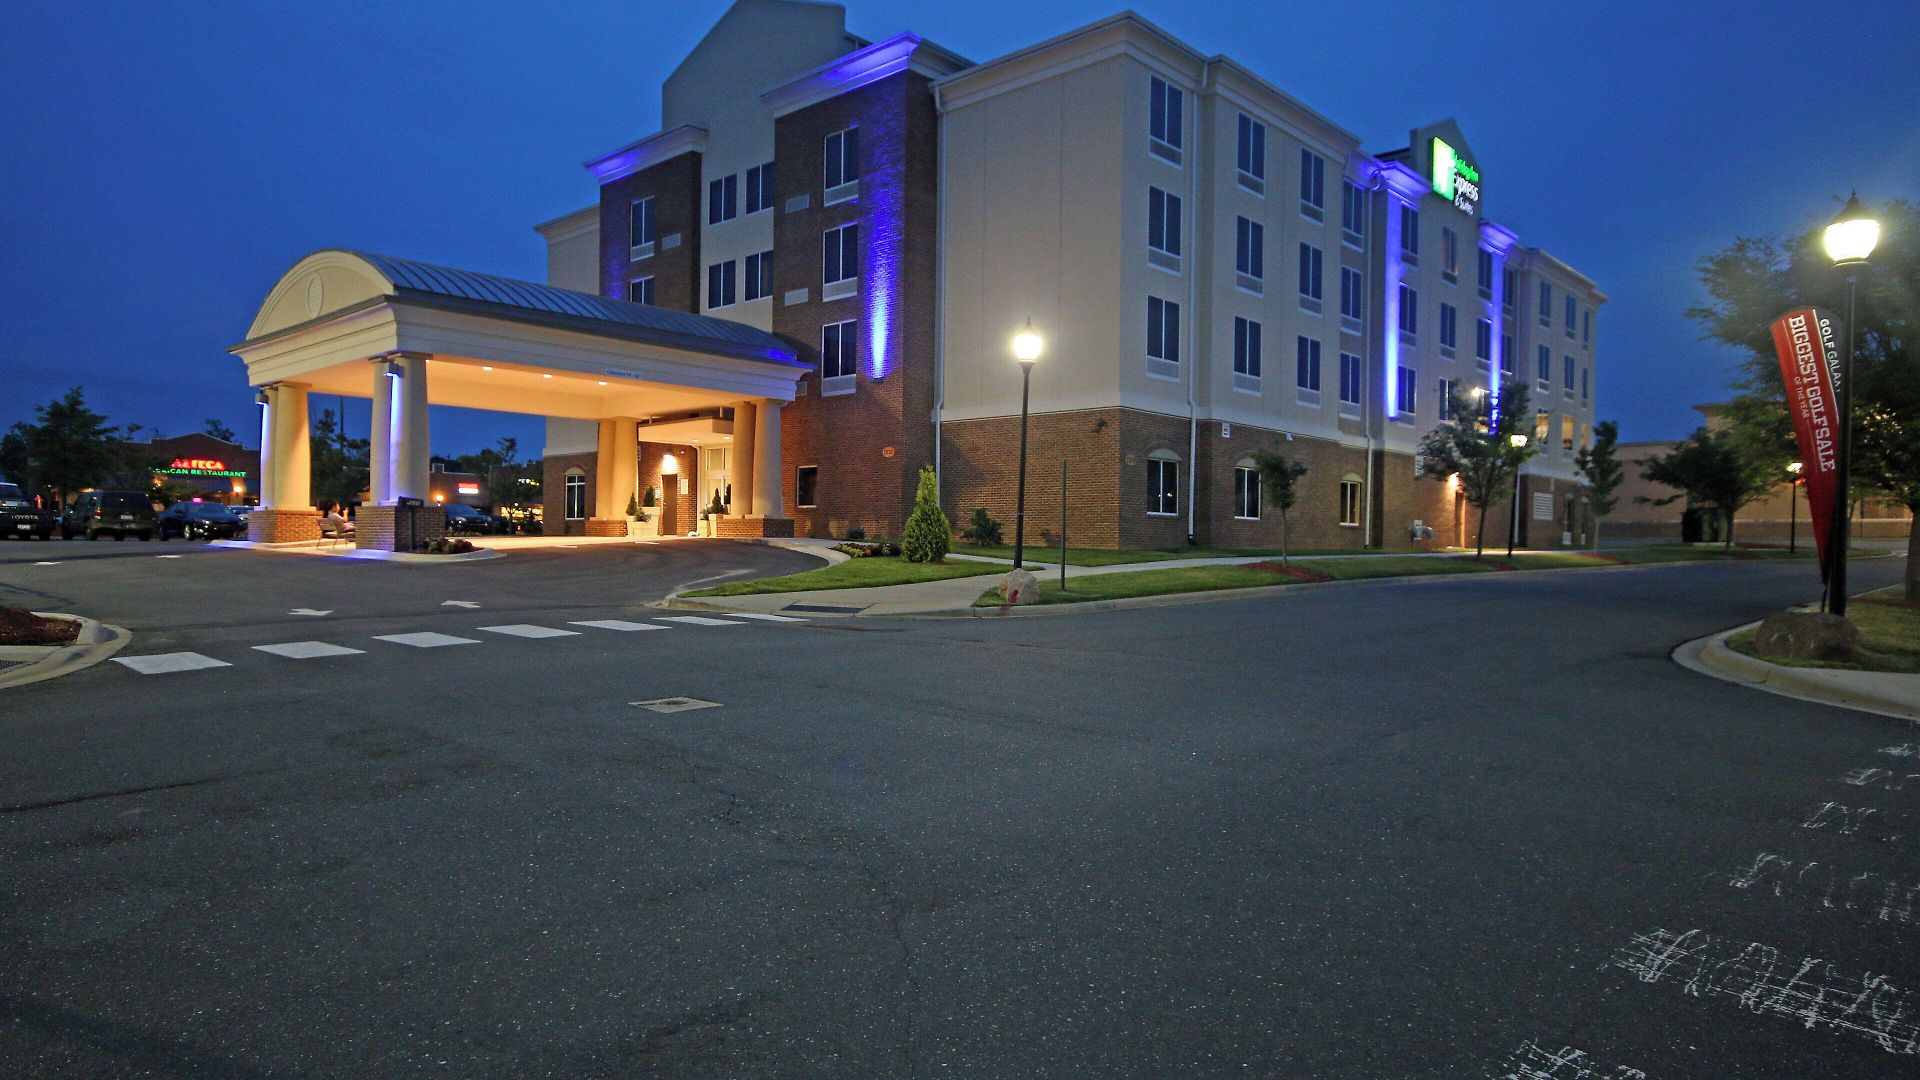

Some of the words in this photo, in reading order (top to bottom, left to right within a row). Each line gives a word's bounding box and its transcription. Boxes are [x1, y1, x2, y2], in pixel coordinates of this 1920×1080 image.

[1820, 318, 1835, 348] GOLF
[1788, 314, 1819, 384] BIGGEST
[1797, 386, 1806, 400] THE
[1806, 386, 1828, 426] GOLF
[1800, 400, 1810, 418] YEAR
[1815, 427, 1836, 472] SALE
[190, 468, 247, 477] RESTAURANT
